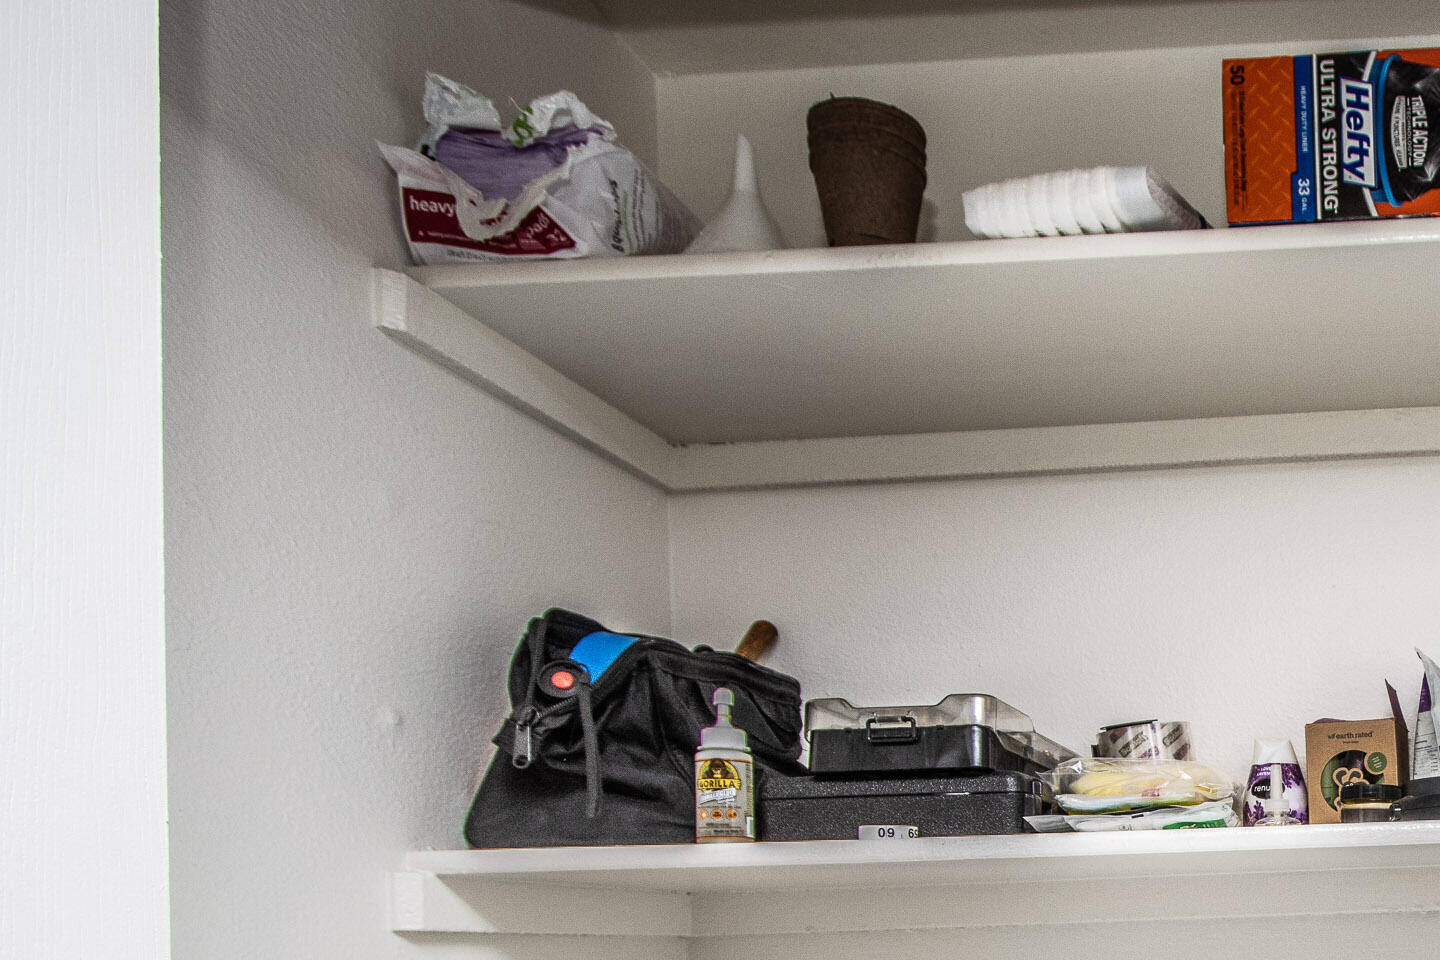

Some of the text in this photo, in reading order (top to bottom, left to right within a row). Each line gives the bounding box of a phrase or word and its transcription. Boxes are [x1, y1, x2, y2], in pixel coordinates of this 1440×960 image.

[1230, 65, 1245, 85] 50
[1320, 60, 1338, 210] ULTRA STRONG
[1342, 84, 1371, 181] Hefty
[1411, 95, 1428, 167] TRIPLE ACTION
[1298, 178, 1310, 195] 33
[409, 195, 456, 217] heavy
[1355, 731, 1373, 739] rated
[699, 780, 736, 788] GORILLA
